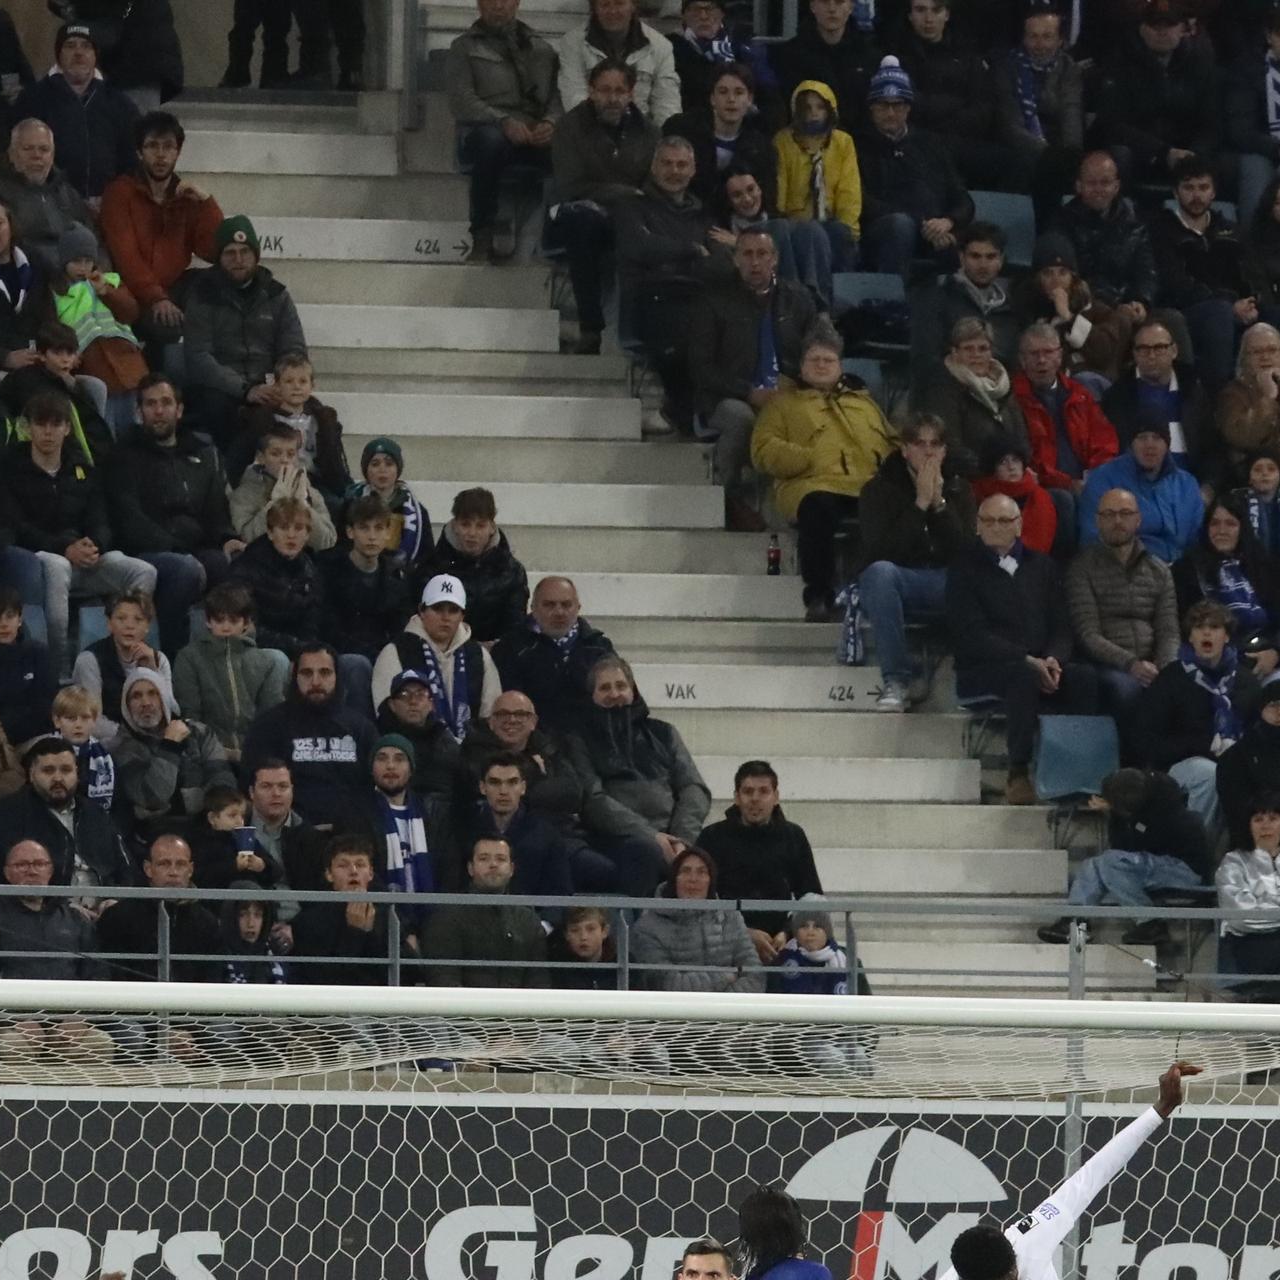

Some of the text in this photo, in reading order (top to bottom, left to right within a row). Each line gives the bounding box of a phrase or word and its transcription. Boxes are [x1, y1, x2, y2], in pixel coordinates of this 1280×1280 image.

[415, 239, 441, 255] 424
[665, 683, 855, 702] VAK 424
